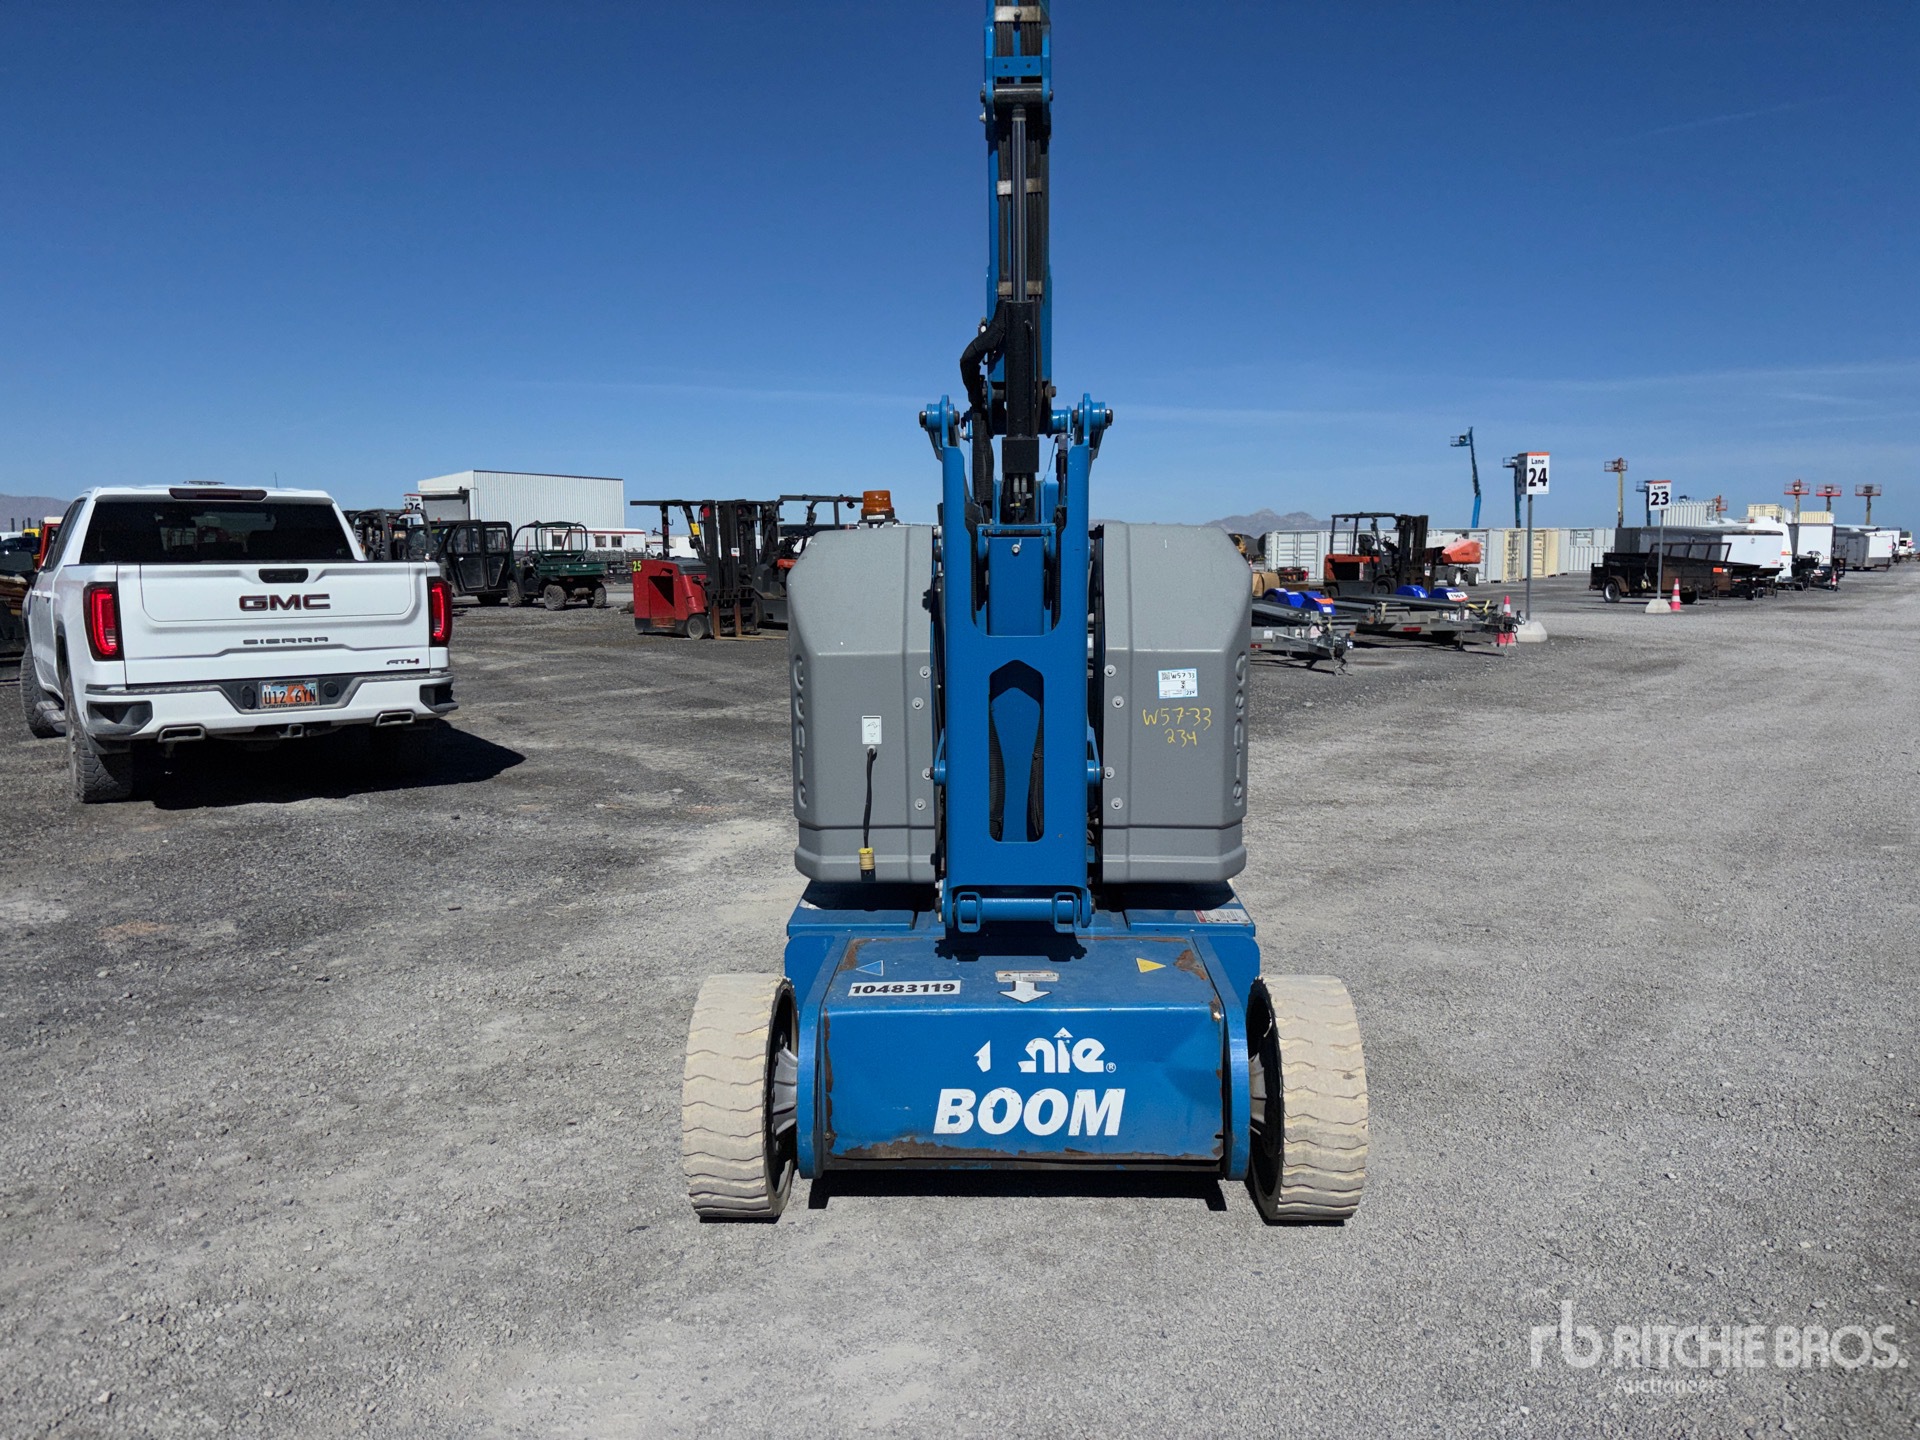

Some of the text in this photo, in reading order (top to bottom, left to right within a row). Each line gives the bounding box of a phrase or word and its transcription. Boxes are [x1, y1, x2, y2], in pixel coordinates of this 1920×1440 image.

[1528, 467, 1548, 487] 24
[1650, 491, 1669, 506] 23
[632, 560, 642, 572] 25
[239, 594, 331, 611] GMC
[243, 636, 329, 645] SIERRA
[386, 658, 420, 666] AT4
[263, 688, 316, 705] U12 6YN
[1142, 707, 1212, 731] W57-33
[1164, 728, 1198, 748] 234
[852, 982, 956, 996] 10483119
[933, 1086, 1126, 1138] BOOM
